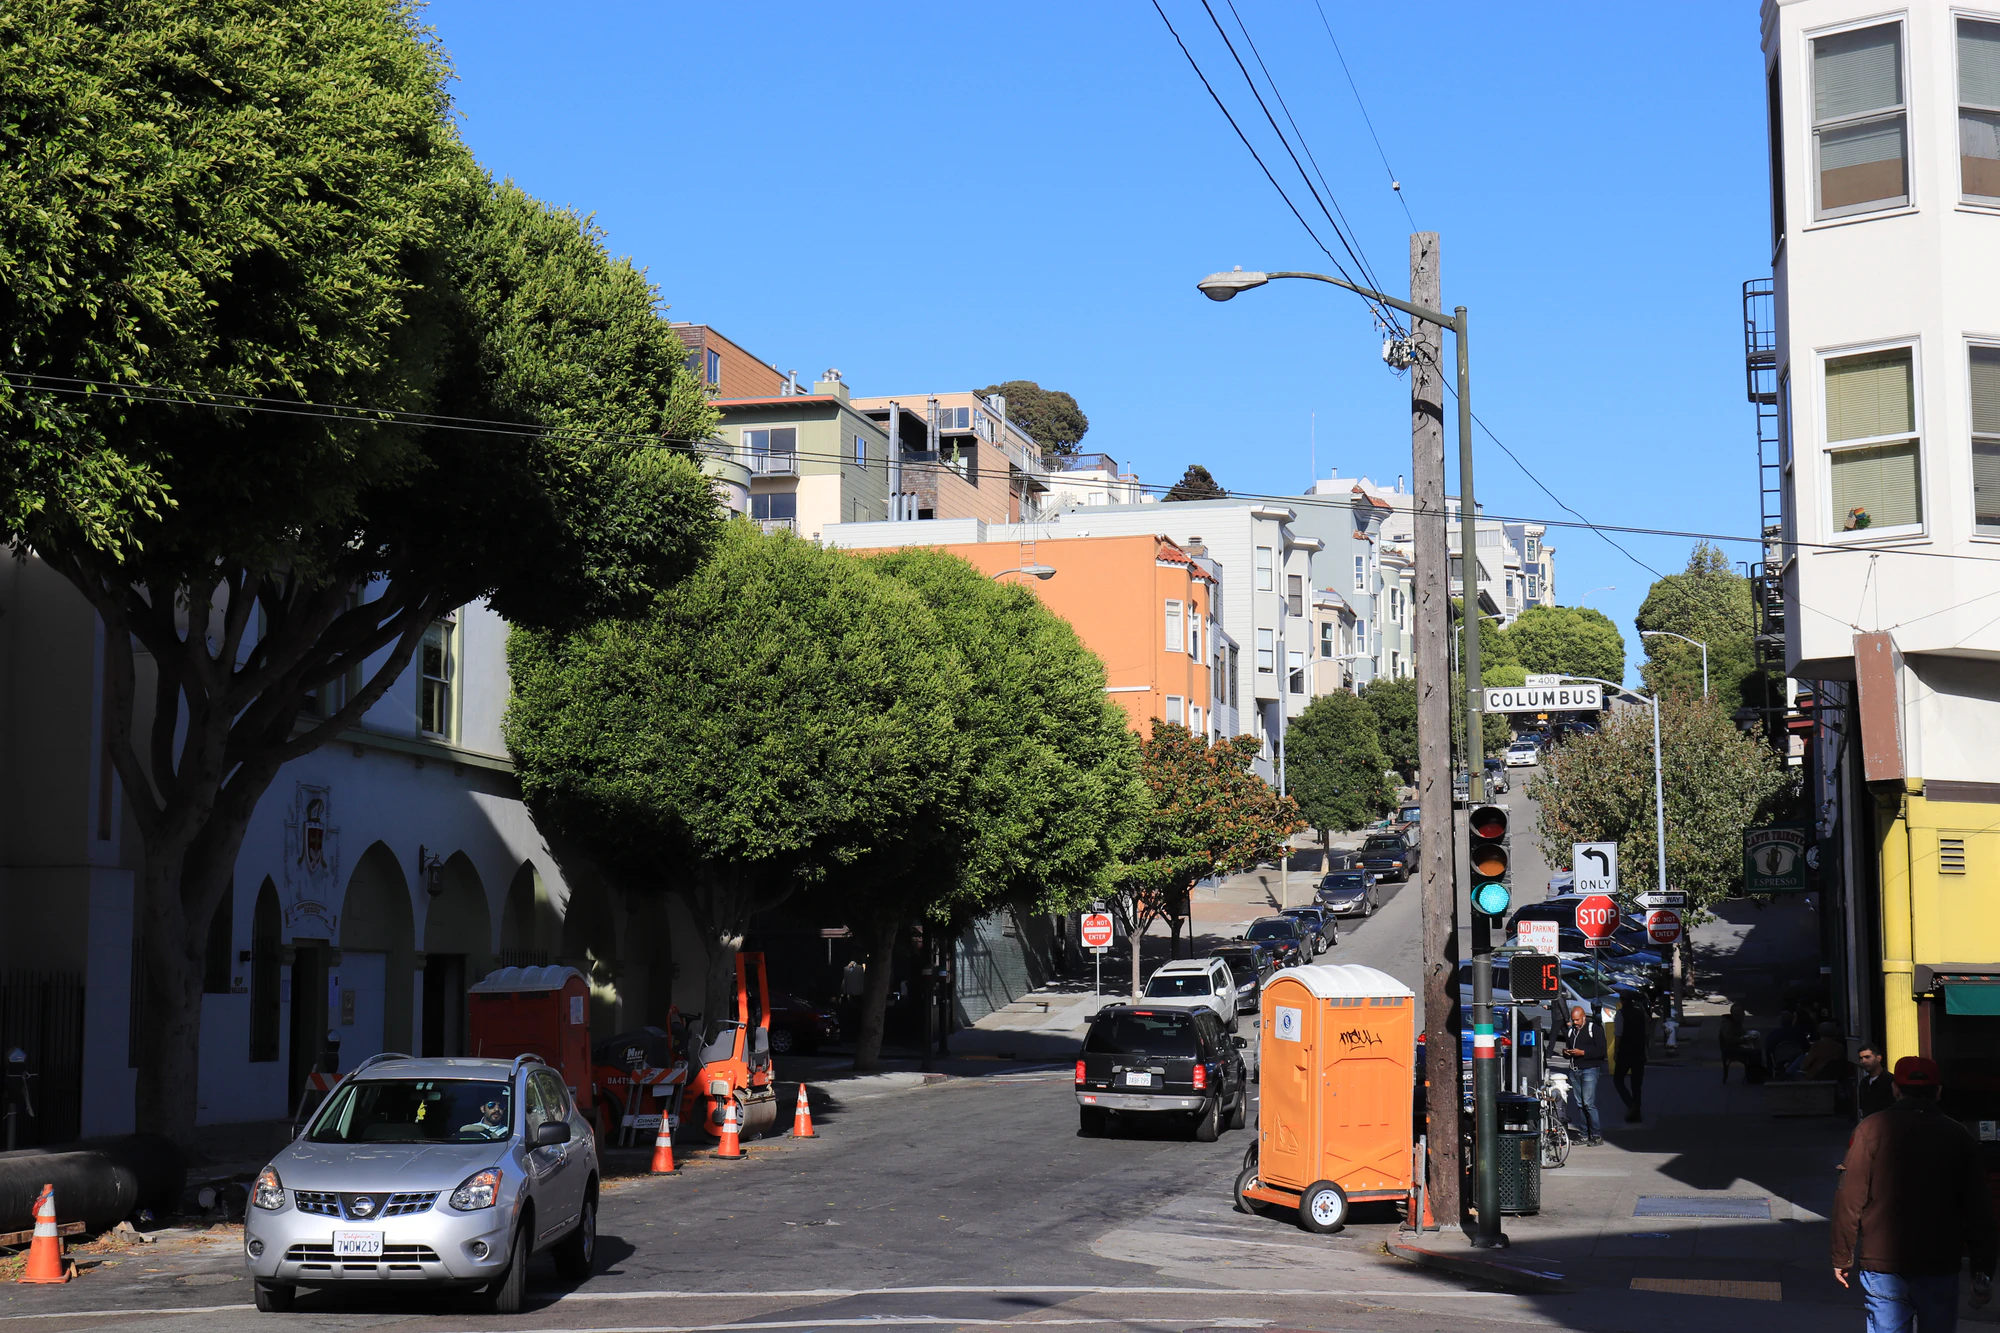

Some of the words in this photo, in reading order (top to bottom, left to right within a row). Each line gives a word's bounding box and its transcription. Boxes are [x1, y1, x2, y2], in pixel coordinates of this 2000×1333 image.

[1538, 676, 1556, 685] 400
[1490, 689, 1597, 707] COLUMBUS
[1580, 879, 1611, 890] ONLY
[1754, 877, 1797, 887] ESPRESSO
[1649, 896, 1664, 904] ONE
[1579, 908, 1617, 925] STOP
[1520, 922, 1530, 933] NO
[1532, 925, 1556, 933] PARKING
[1542, 963, 1558, 991] 15
[337, 1240, 380, 1252] 7WOW219
